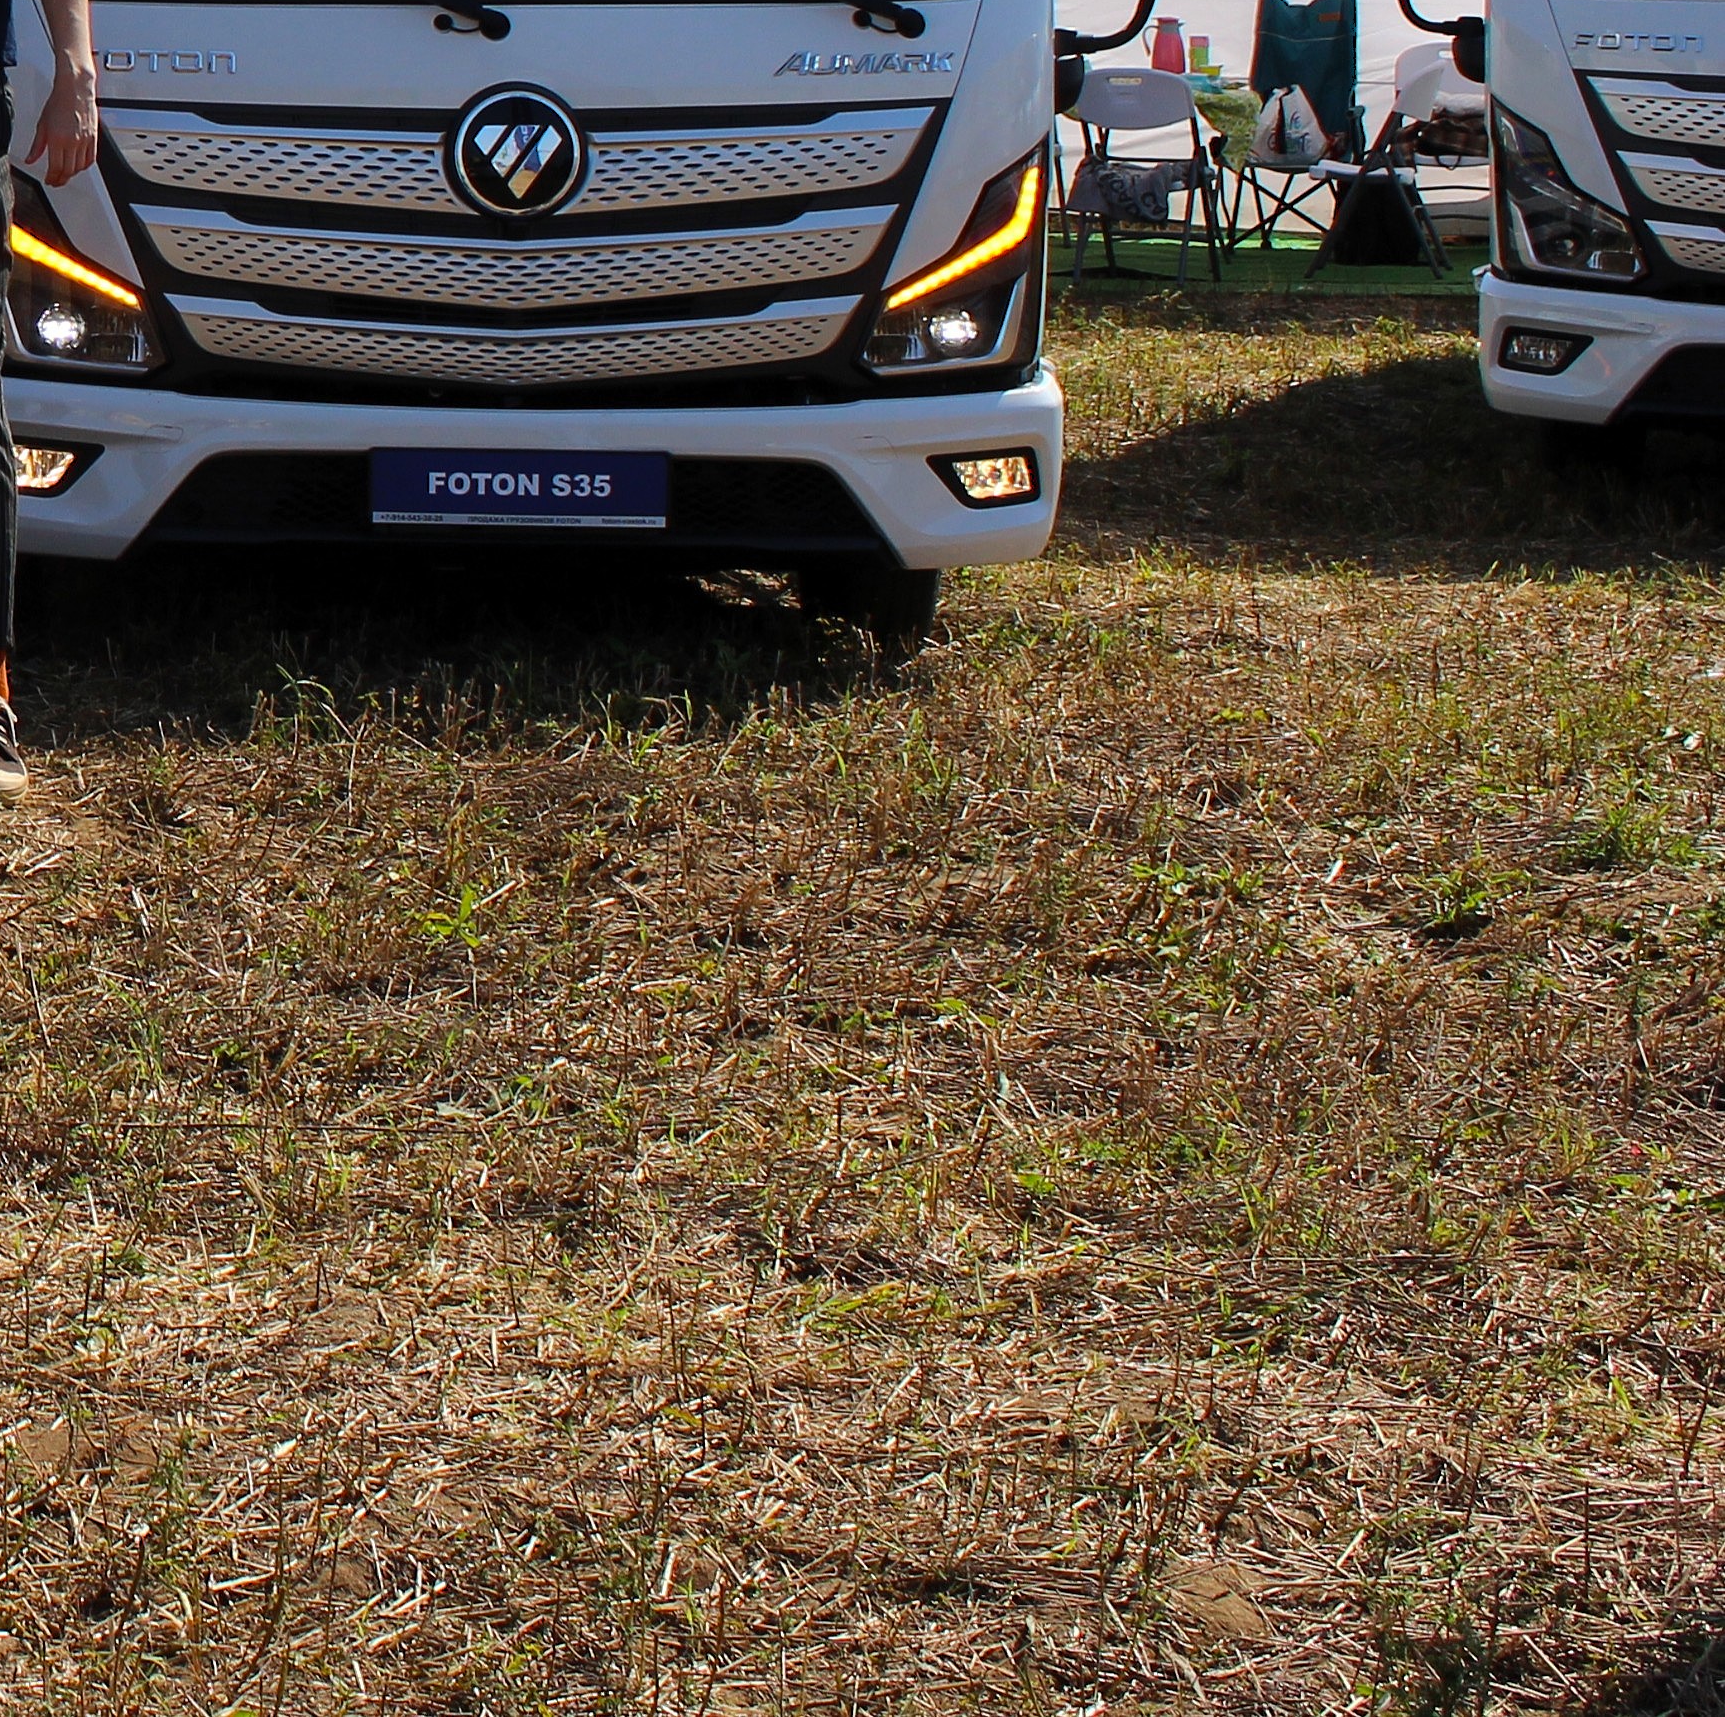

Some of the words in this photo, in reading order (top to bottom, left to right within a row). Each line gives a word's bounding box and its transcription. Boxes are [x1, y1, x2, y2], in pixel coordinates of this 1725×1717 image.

[1571, 31, 1703, 53] FOTON
[92, 48, 237, 74] OTON
[773, 50, 955, 77] AUMARK
[428, 471, 540, 496] FOTON
[551, 474, 612, 497] S35
[555, 517, 582, 525] FOTON
